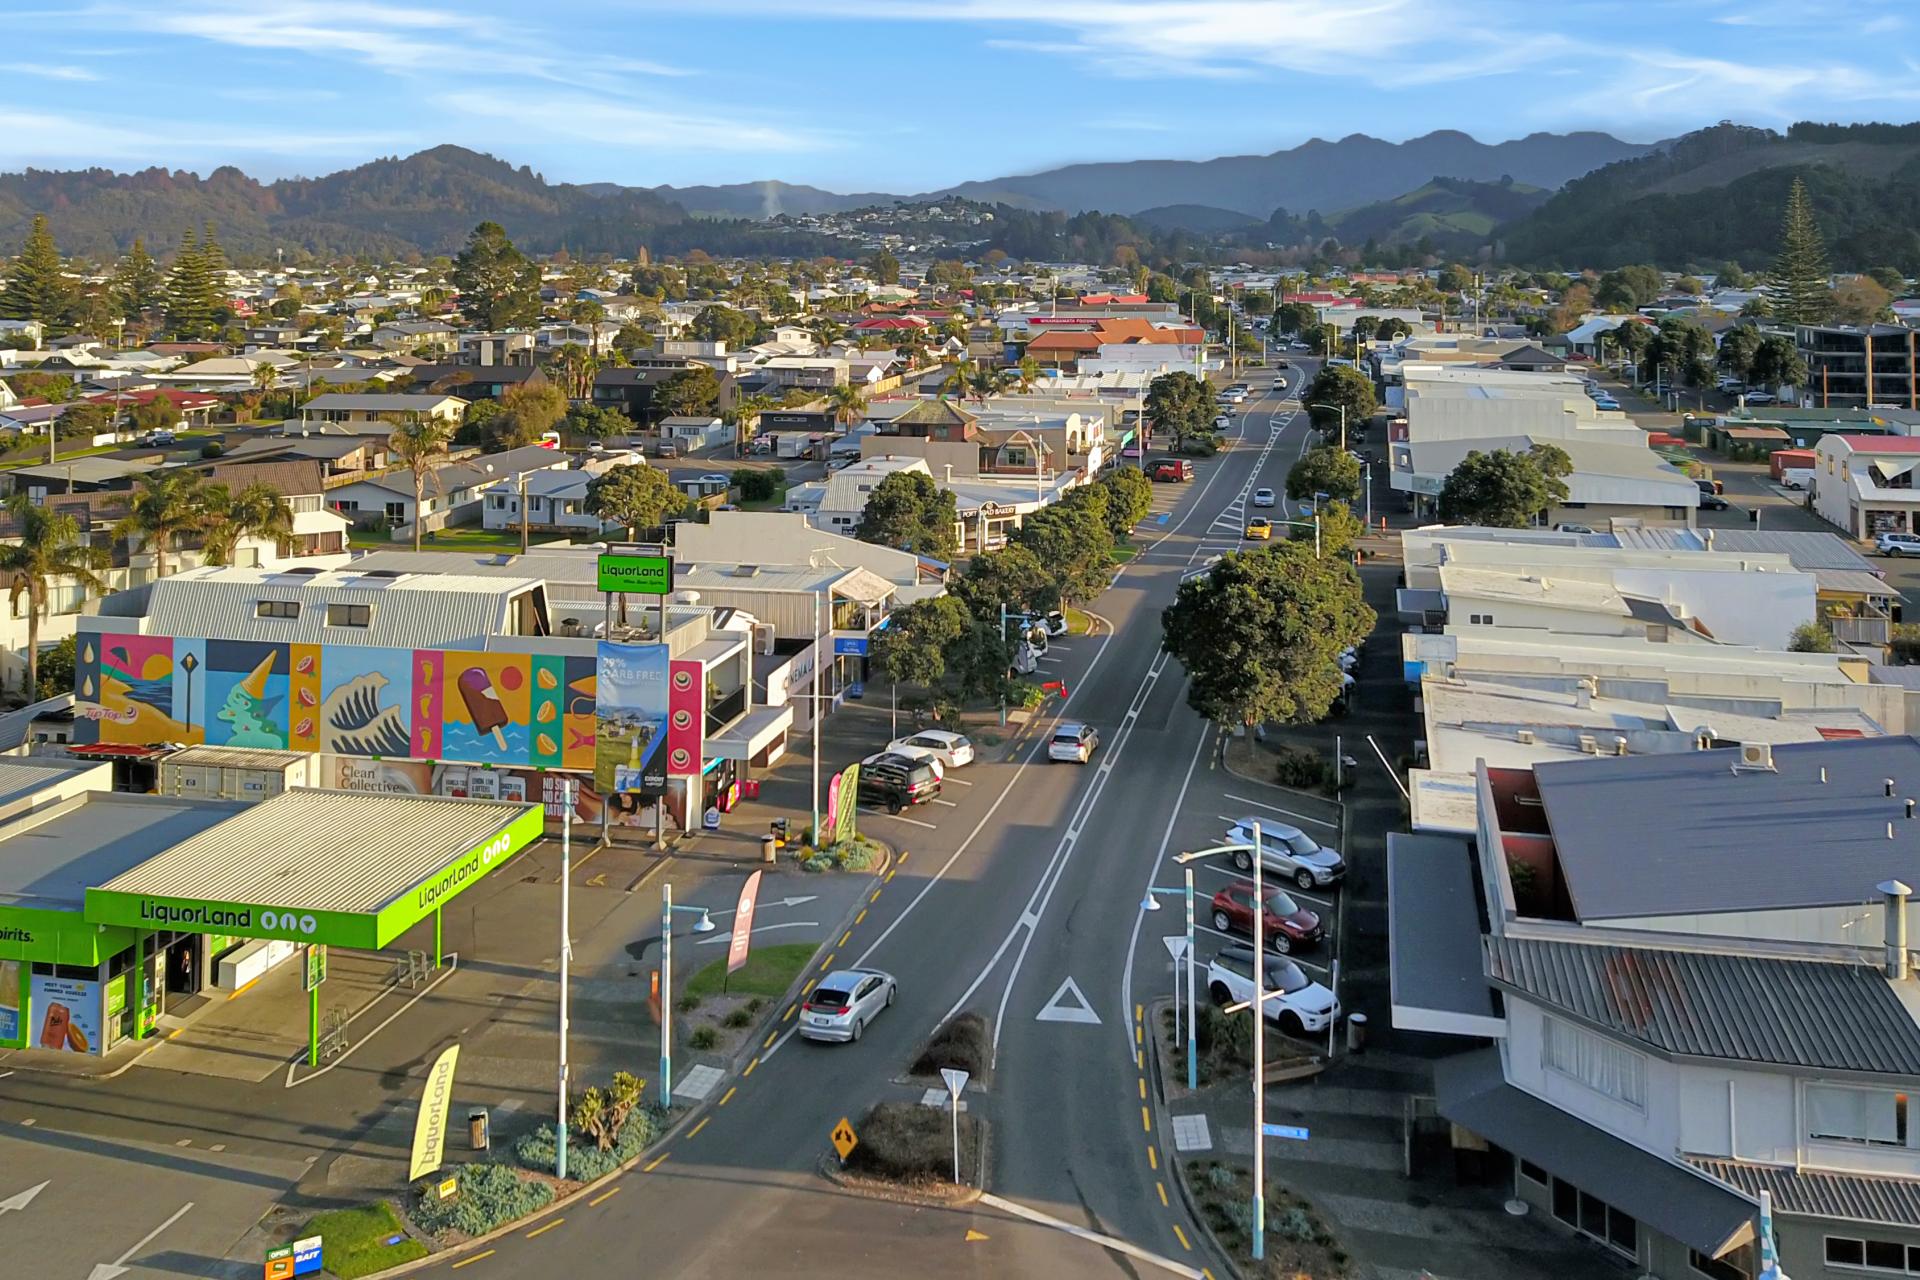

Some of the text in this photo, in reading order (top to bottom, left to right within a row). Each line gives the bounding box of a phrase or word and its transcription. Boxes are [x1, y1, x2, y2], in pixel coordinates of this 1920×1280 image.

[995, 506, 1015, 515] BAKERY
[602, 564, 664, 577] LiquorLand
[601, 668, 663, 682] CARB FREE
[341, 764, 376, 778] Clean
[341, 778, 400, 793] Collective
[543, 777, 580, 792] NO SUAR
[543, 789, 554, 803] NO
[418, 853, 480, 909] LiquorLand
[140, 900, 251, 928] LiquorLand
[422, 1061, 450, 1165] LiquorLand
[271, 1249, 290, 1259] OPEN
[295, 1250, 320, 1263] BAIT
